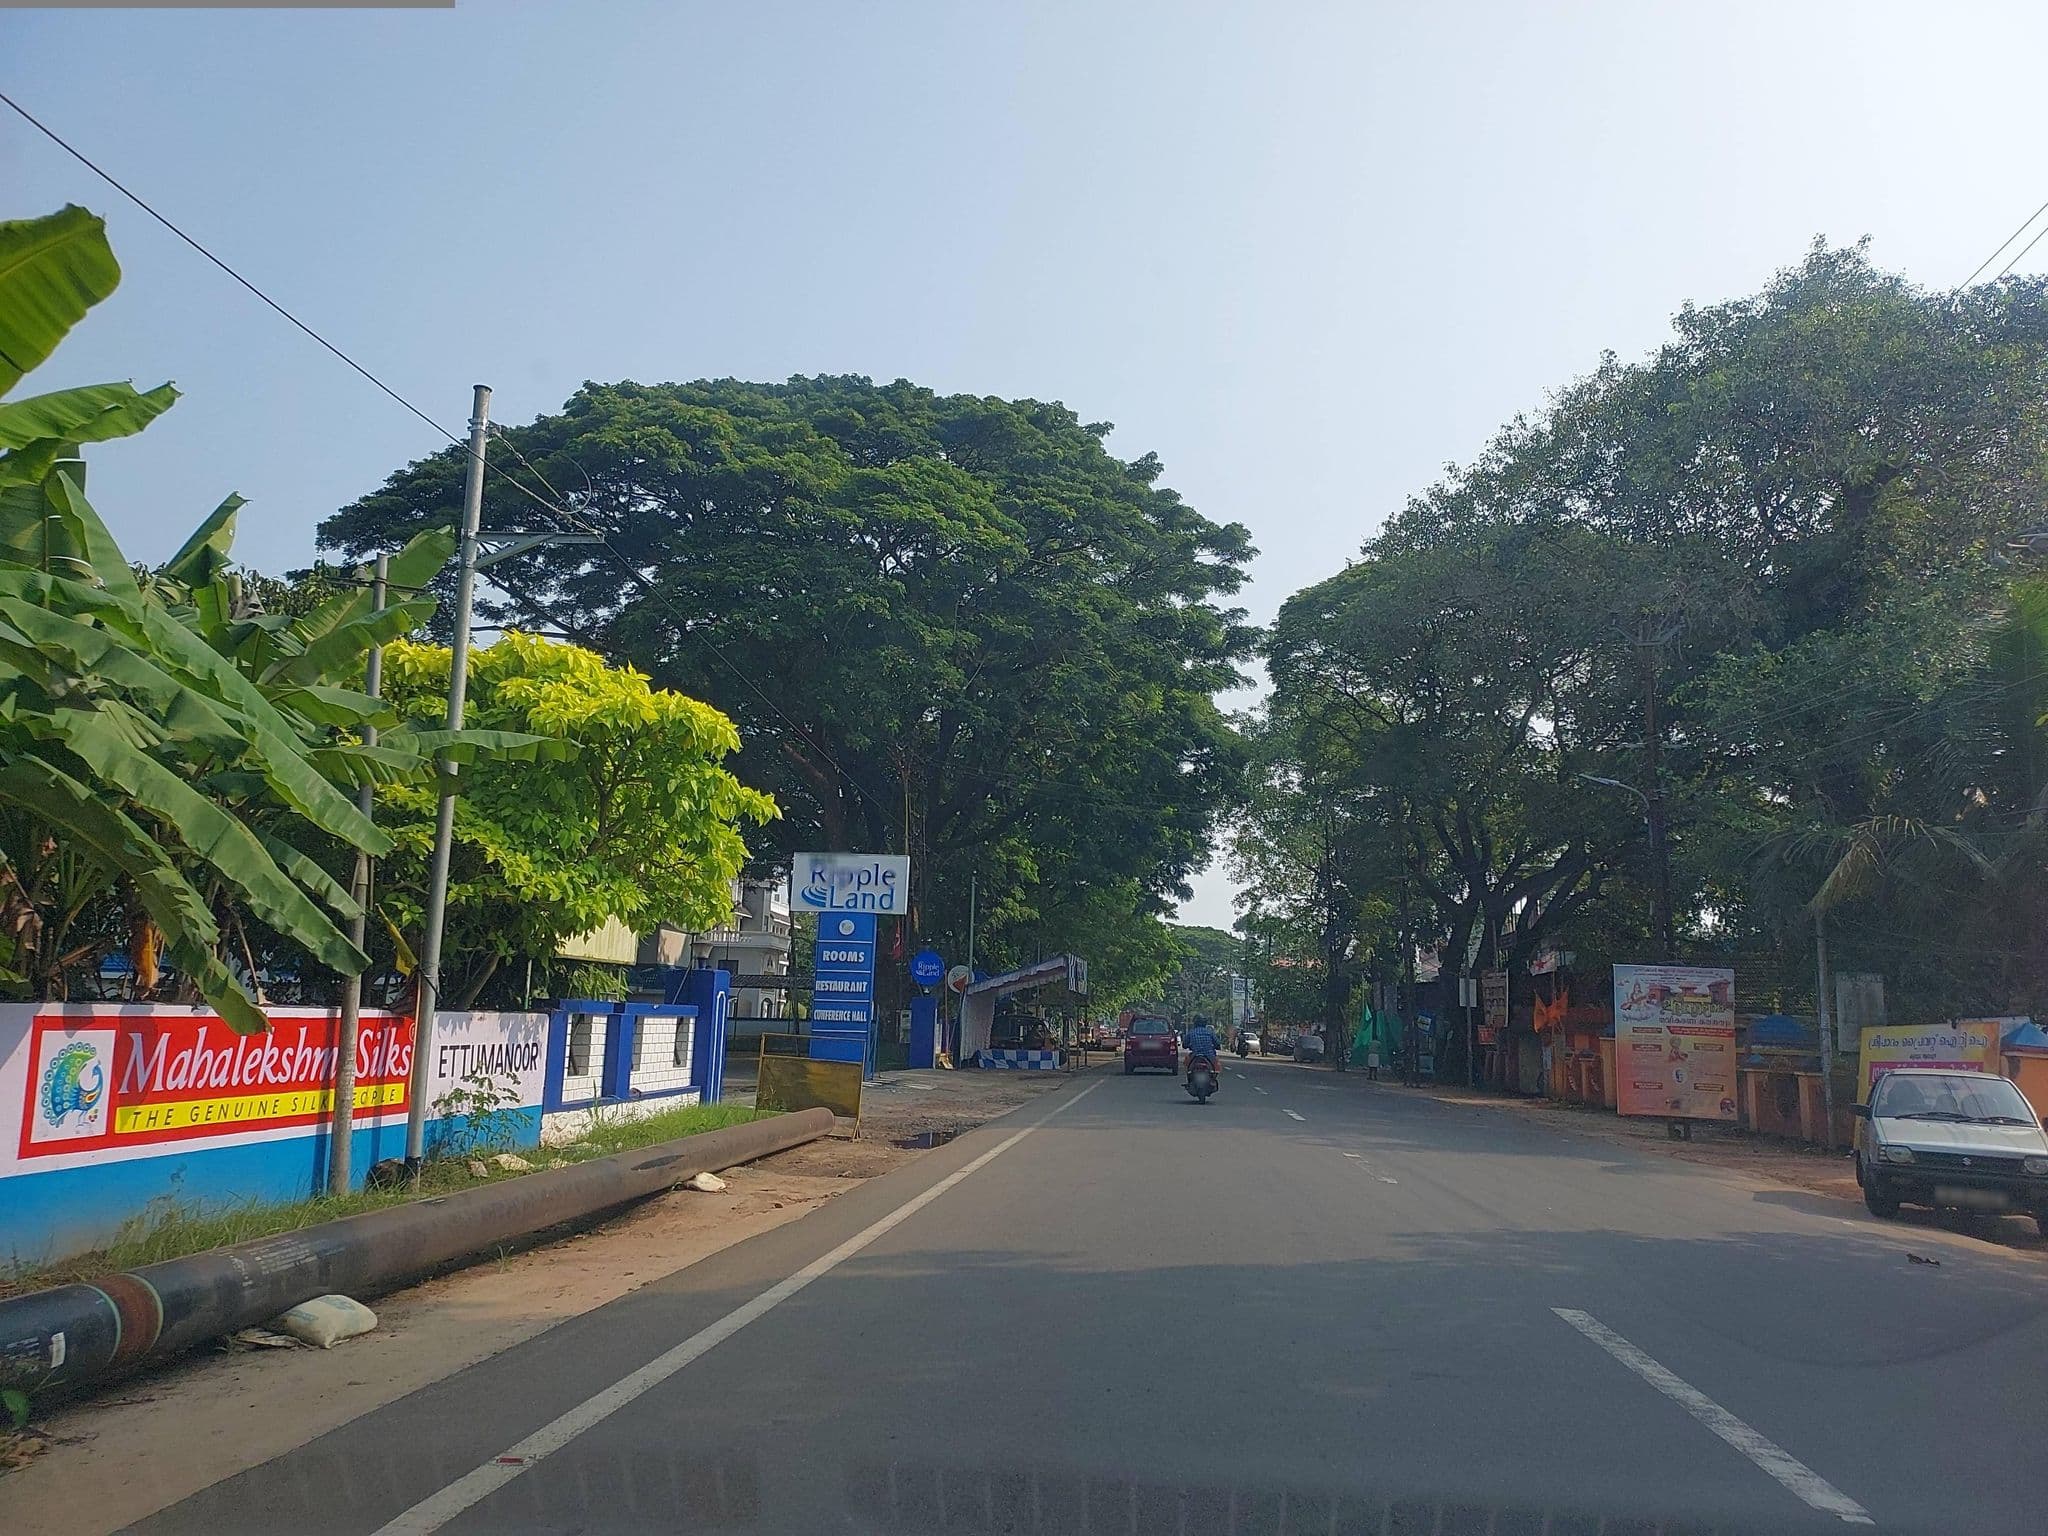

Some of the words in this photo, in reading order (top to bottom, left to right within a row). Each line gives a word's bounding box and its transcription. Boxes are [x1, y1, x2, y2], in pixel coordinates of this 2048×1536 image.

[830, 885, 895, 910] Land
[822, 950, 865, 963] ROOMS
[917, 960, 940, 971] Ripple
[815, 980, 868, 993] RESTAURANT
[813, 1009, 851, 1021] CONFERENCE
[851, 1010, 867, 1022] HALL
[118, 1026, 340, 1094] Mahalekshm
[354, 1026, 412, 1079] Silks
[438, 1042, 539, 1079] ETTUMANOOR
[131, 1108, 174, 1130] THE
[190, 1098, 280, 1123] GENUINE
[291, 1094, 329, 1112] SILK
